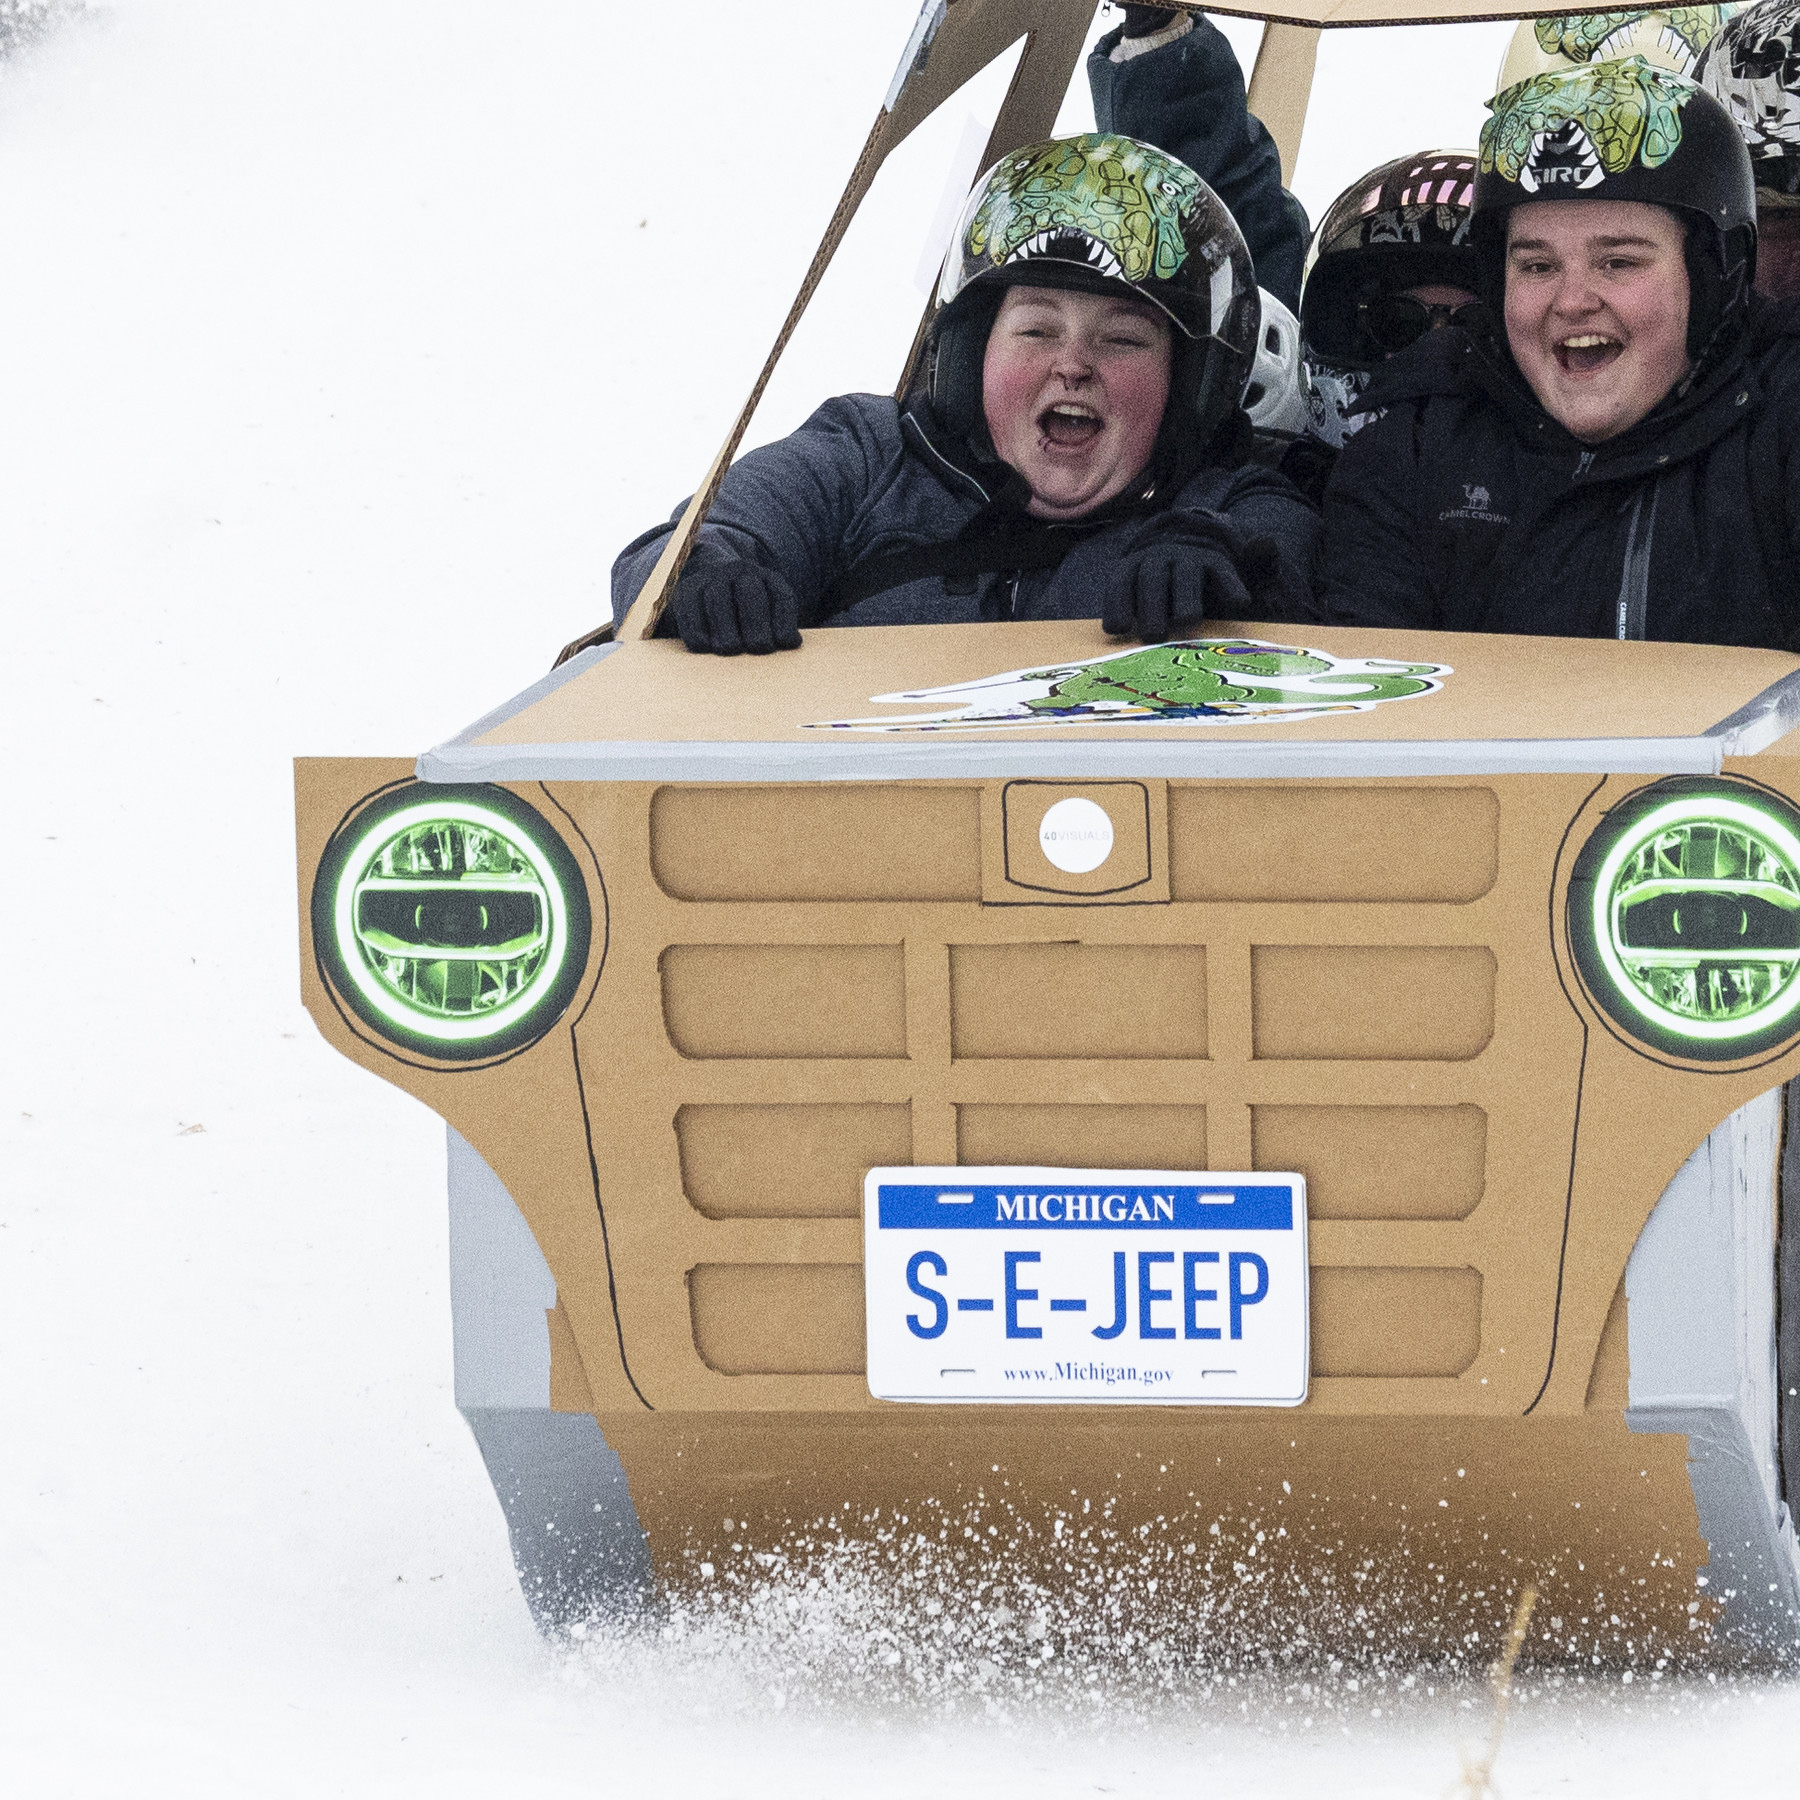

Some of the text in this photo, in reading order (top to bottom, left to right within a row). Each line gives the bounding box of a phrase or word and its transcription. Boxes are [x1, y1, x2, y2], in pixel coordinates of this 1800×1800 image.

[995, 1193, 1176, 1222] MICHIGAN
[904, 1249, 1271, 1341] S-E-JEEP
[1003, 1360, 1175, 1386] www.Michigan.gov
